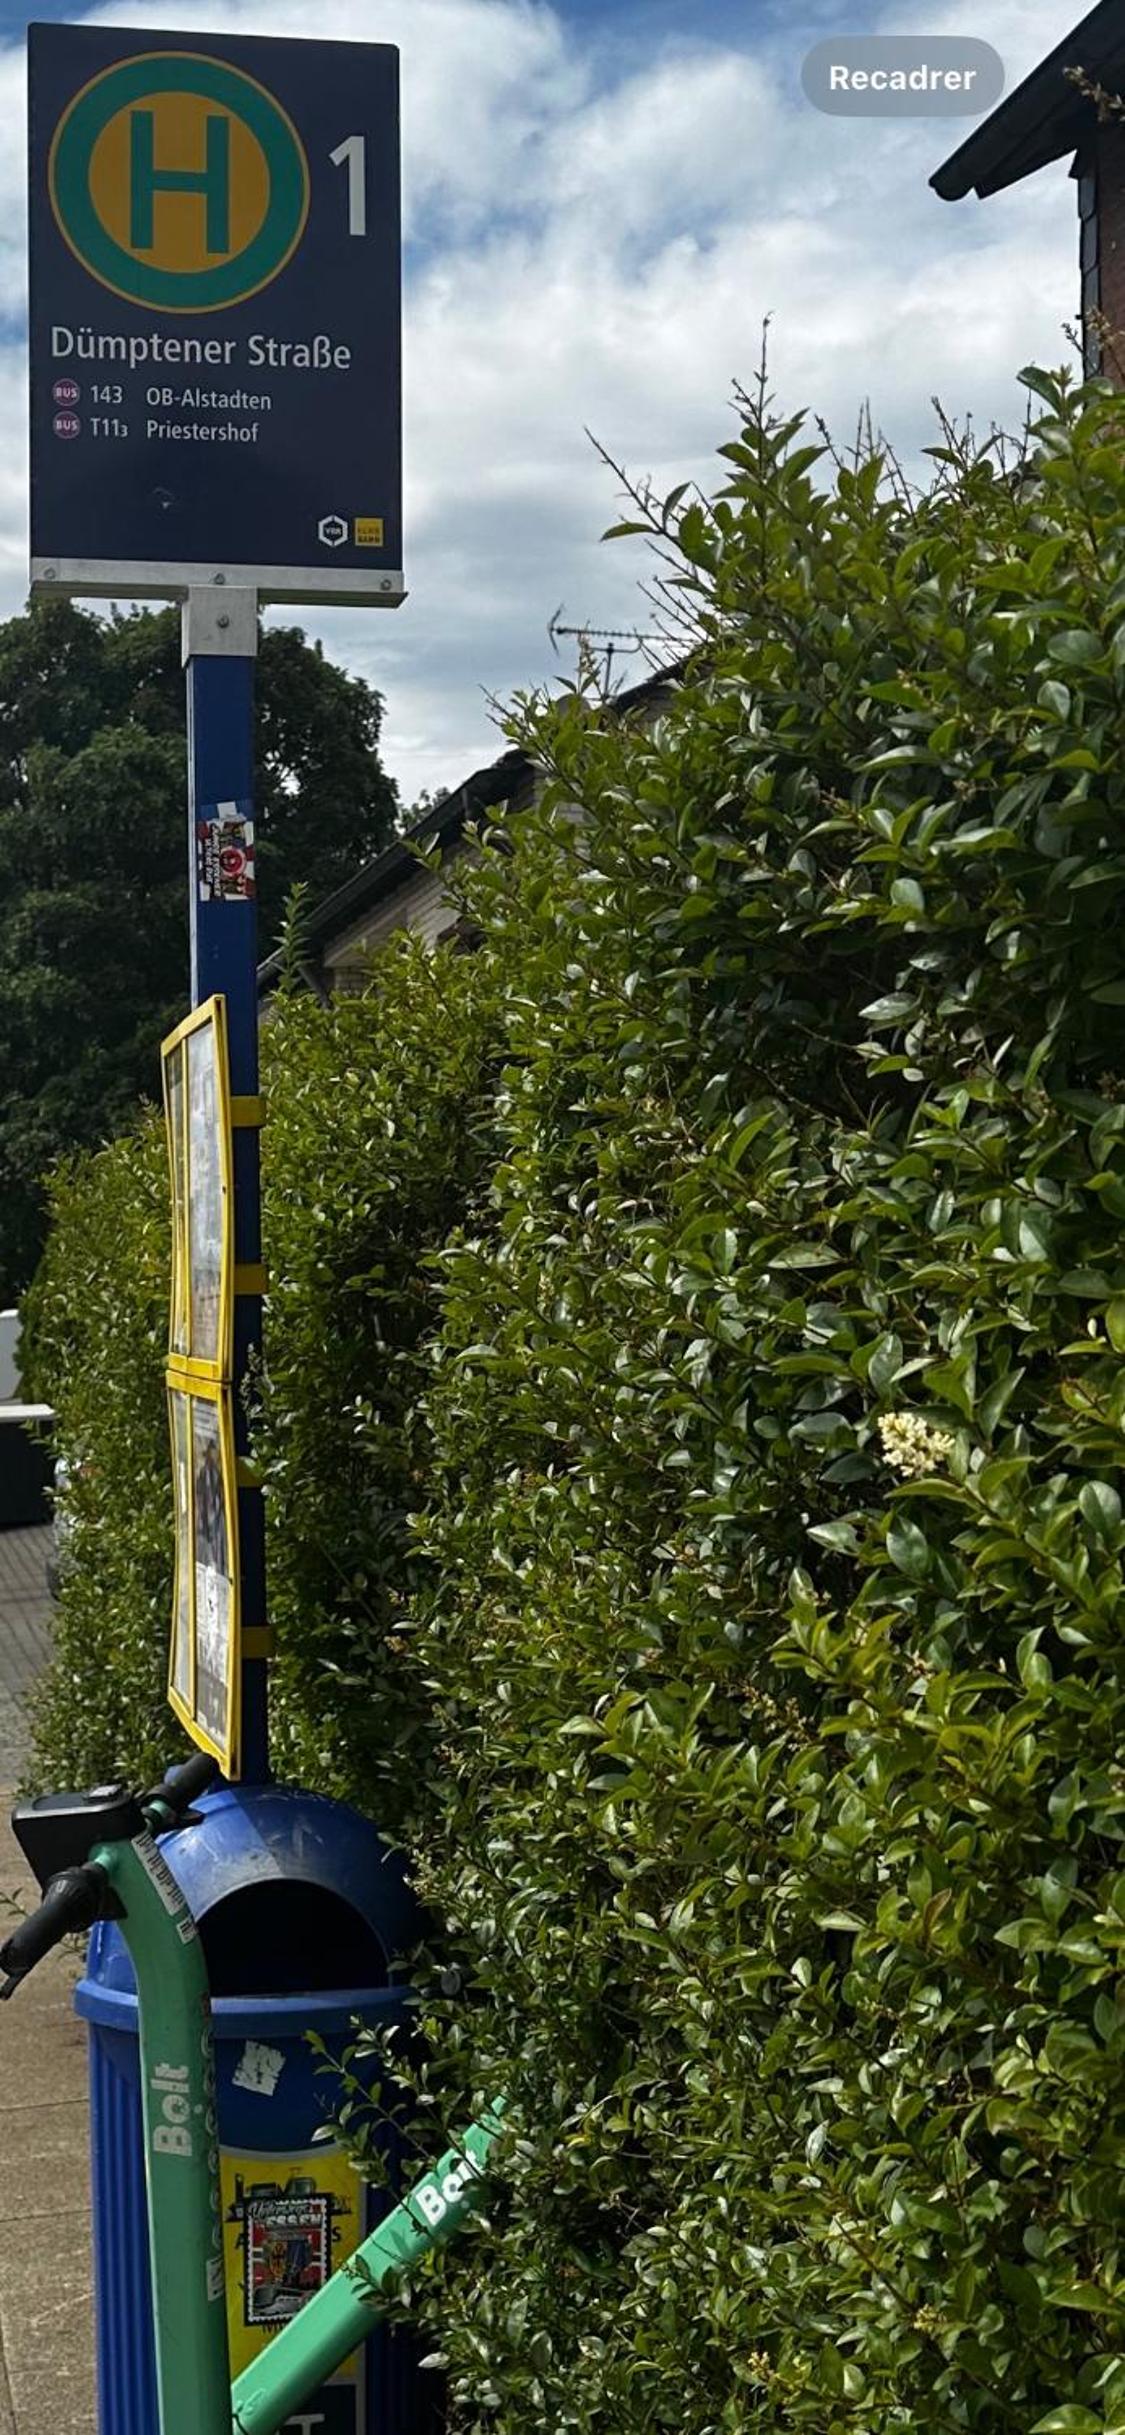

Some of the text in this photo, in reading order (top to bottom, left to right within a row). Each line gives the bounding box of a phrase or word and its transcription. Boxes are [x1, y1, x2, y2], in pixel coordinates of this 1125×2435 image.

[130, 110, 230, 254] H
[328, 135, 367, 236] 1
[51, 326, 352, 370] Dümptener Straße
[55, 384, 272, 411] BUS 143 OB-Alstadten
[55, 420, 78, 431] BUS
[146, 419, 260, 443] Priestershof
[151, 2062, 193, 2157] Bolt
